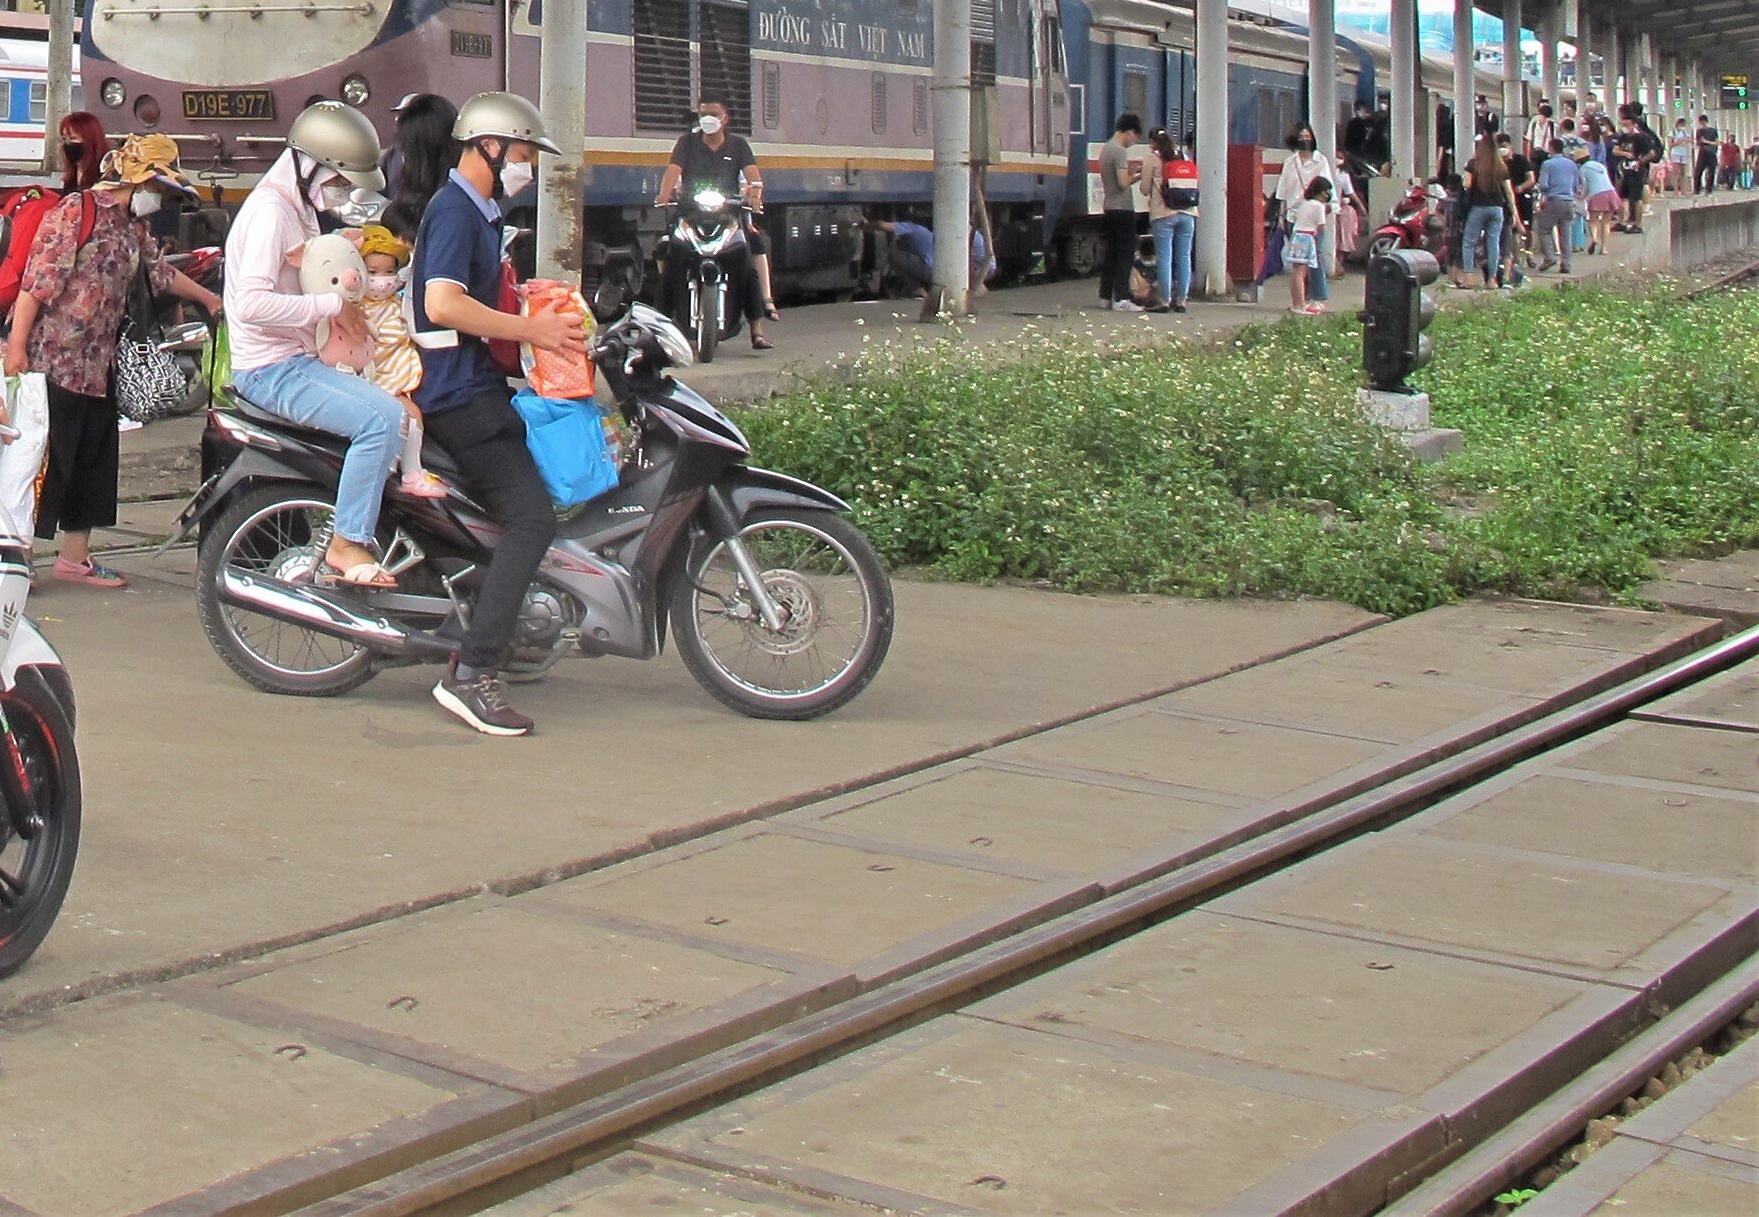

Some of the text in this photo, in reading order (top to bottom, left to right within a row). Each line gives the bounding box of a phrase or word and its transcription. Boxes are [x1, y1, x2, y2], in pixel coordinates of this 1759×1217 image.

[759, 6, 925, 59] ĐƯỜNG SẮT VIỆT NAM
